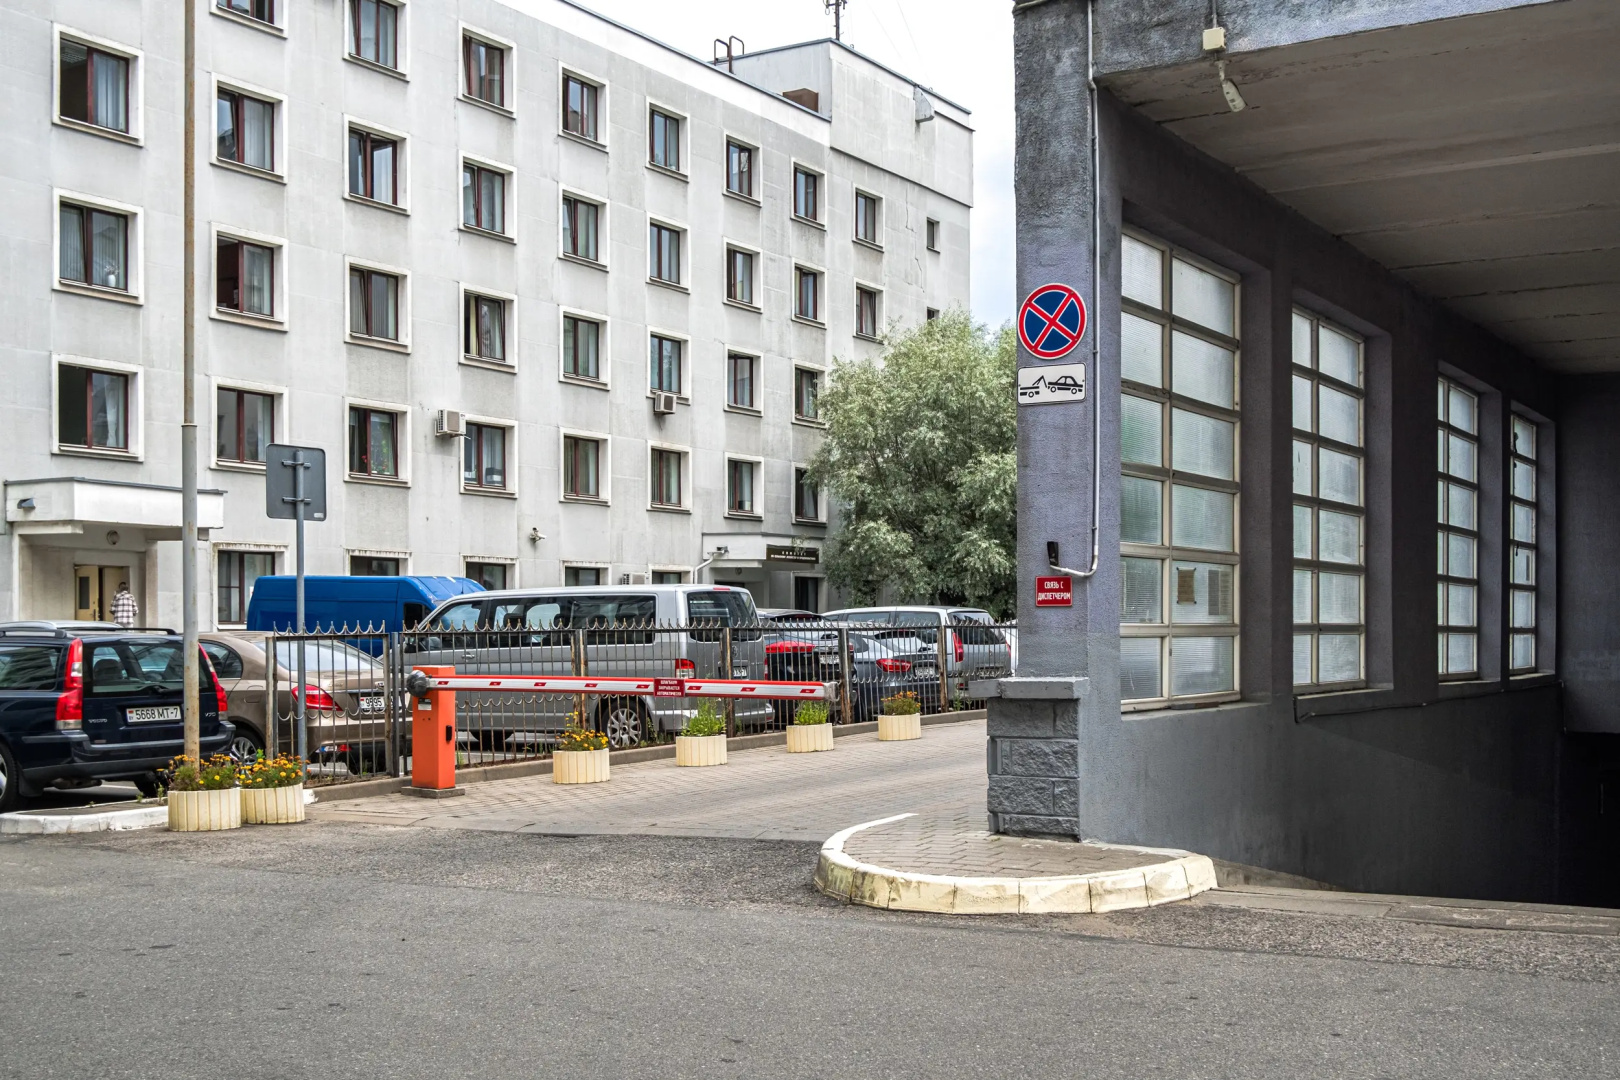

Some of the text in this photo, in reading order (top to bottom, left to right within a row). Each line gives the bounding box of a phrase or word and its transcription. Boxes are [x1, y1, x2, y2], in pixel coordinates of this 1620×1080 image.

[1038, 592, 1070, 601] ДИСПЕТЧЕРОМ
[135, 707, 178, 720] 5668 MT-7
